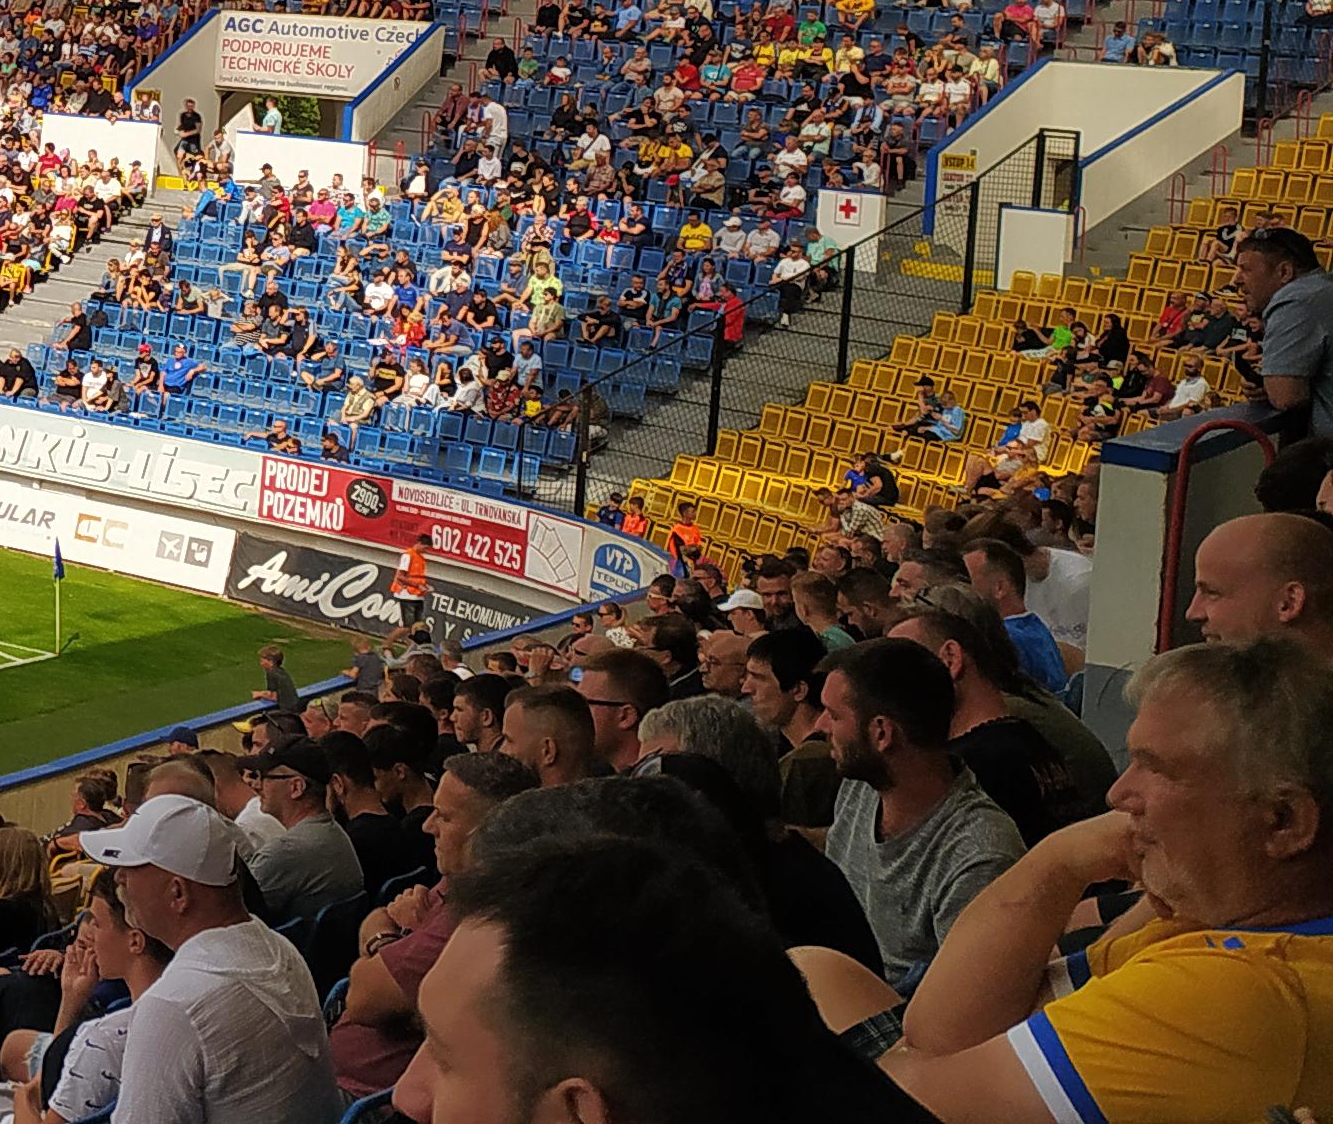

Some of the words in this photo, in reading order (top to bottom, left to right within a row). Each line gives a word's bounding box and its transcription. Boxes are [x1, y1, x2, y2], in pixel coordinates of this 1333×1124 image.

[223, 16, 264, 35] AGC
[267, 20, 369, 42] Automotive
[222, 38, 332, 60] PODPORUJEME
[221, 55, 302, 75] TECHNICKÉ
[304, 59, 355, 80] ŠKOLY
[265, 459, 330, 498] PRODEJ
[262, 489, 345, 532] POZEMKŮ
[350, 484, 385, 514] 2900,-
[397, 486, 454, 510] NOVOSEDLICE
[474, 501, 522, 527] TRNOVANSKÁ
[431, 524, 462, 555] 602
[464, 532, 492, 563] 422
[493, 539, 522, 571] 525
[606, 546, 634, 574] VTP
[596, 569, 635, 591] TEPLIC
